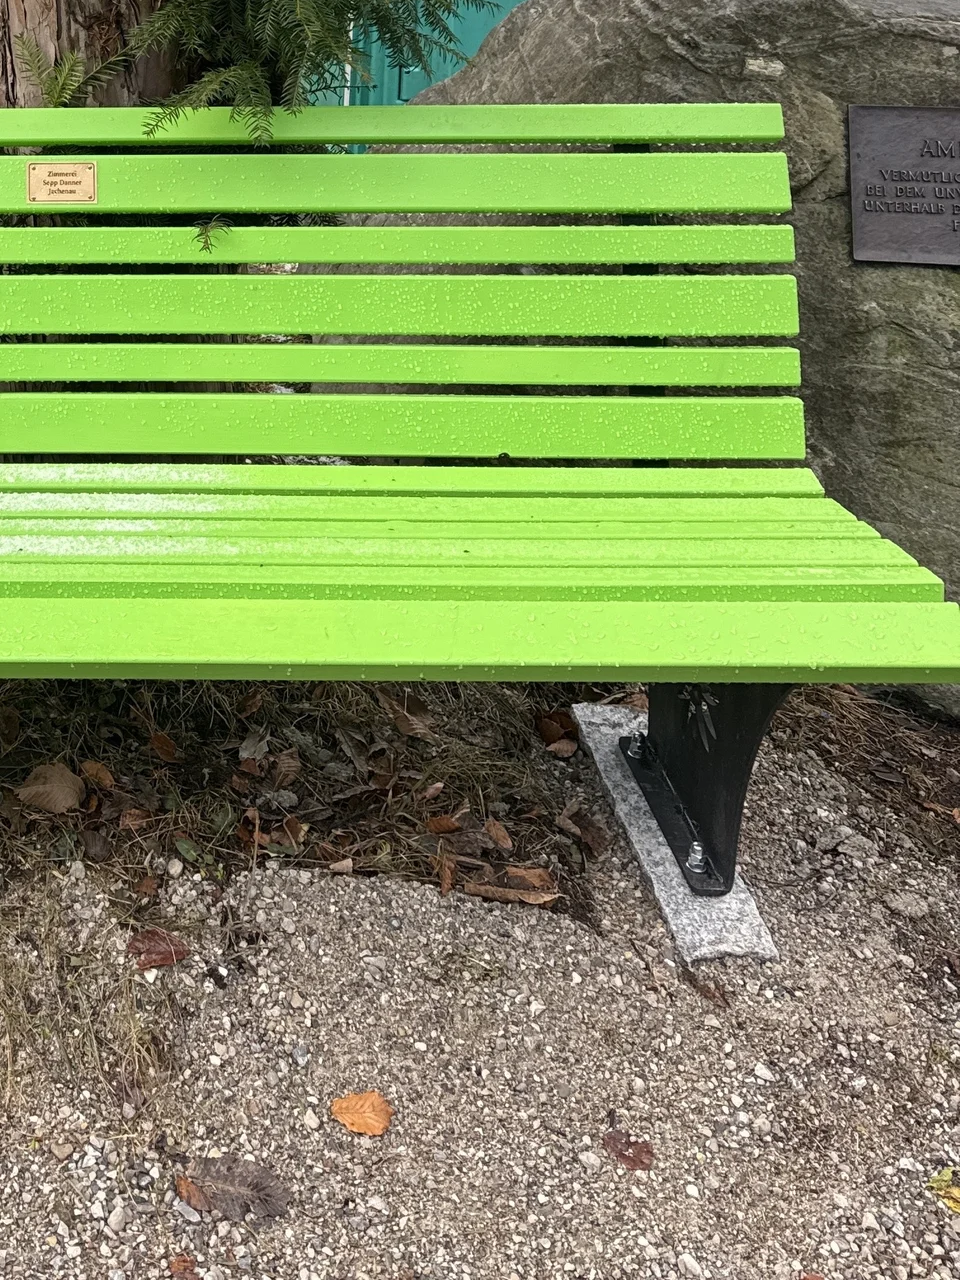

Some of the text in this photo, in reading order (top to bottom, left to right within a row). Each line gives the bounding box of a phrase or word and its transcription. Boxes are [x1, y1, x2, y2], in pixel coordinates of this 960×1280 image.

[42, 179, 58, 187] Sepp
[866, 185, 887, 197] BEI
[895, 185, 926, 198] DEM
[863, 200, 946, 215] UNTERHALB
